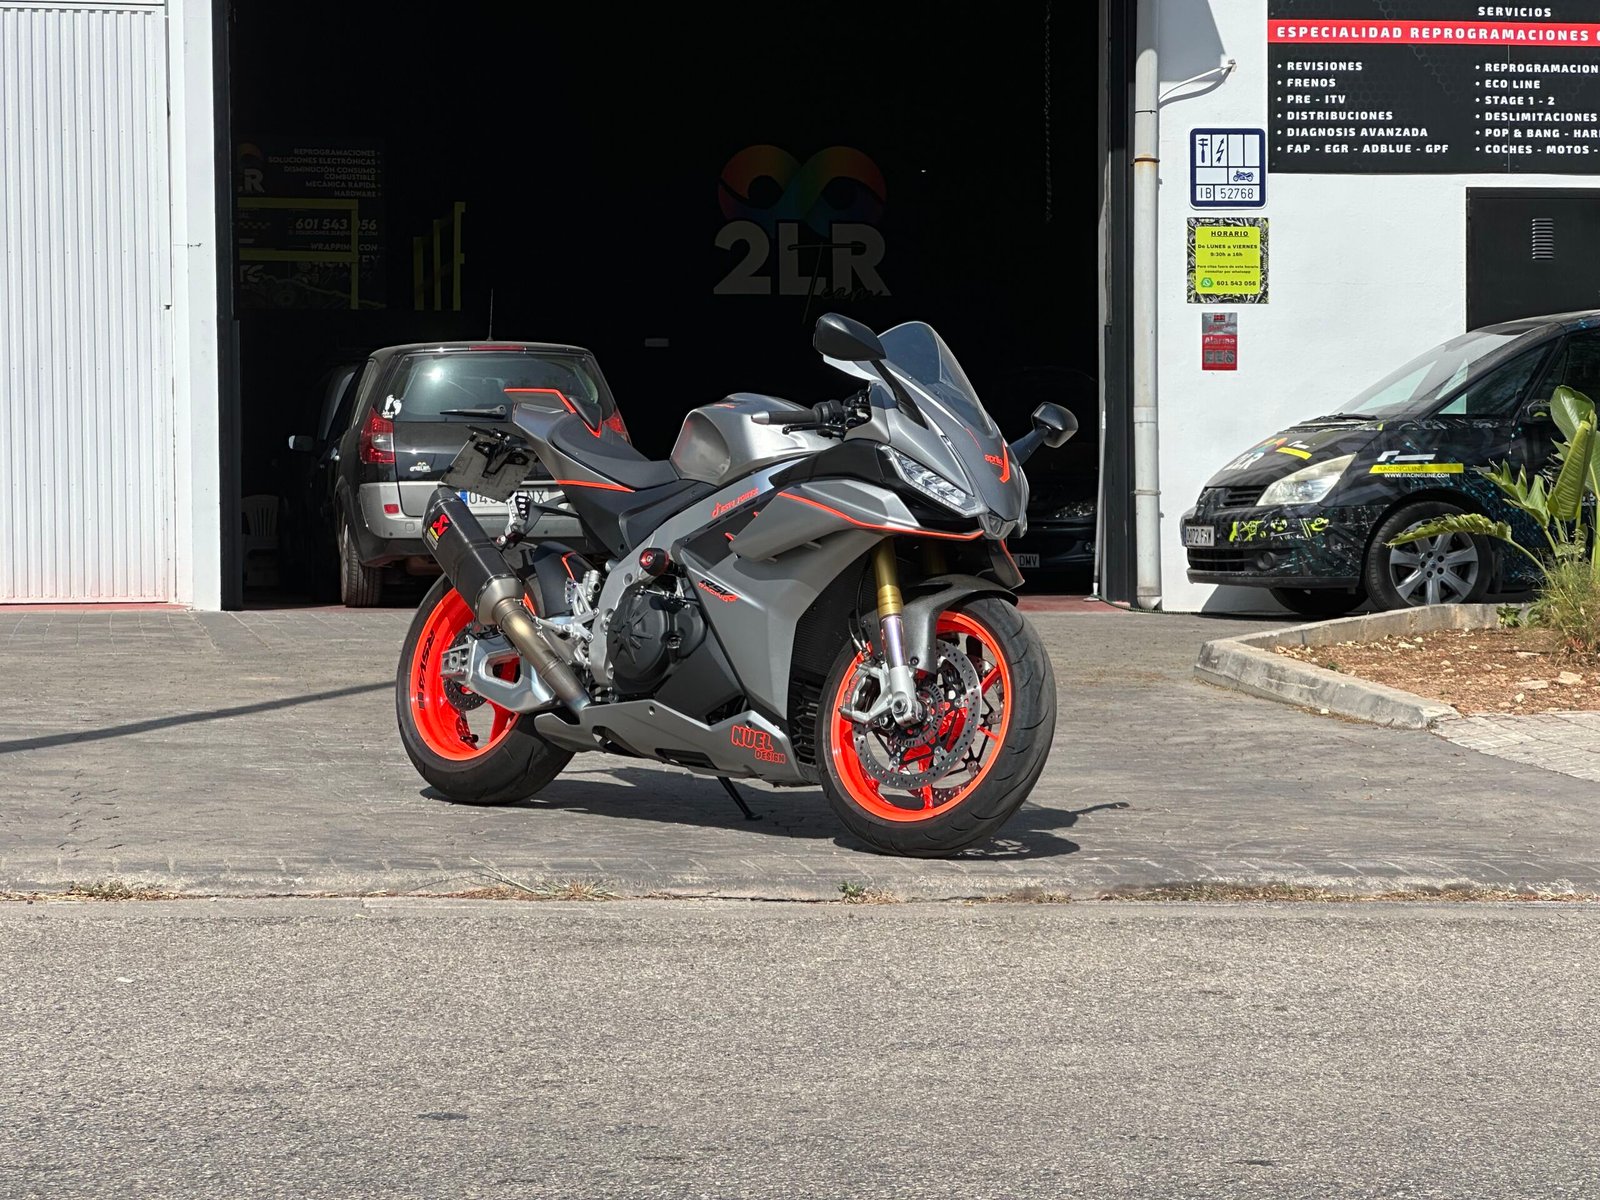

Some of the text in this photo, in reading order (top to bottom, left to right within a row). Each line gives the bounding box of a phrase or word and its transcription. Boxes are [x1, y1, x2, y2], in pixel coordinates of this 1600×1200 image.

[1478, 6, 1552, 17] SERVICIOS
[1277, 26, 1402, 39] ESPECIALIDAD
[1410, 27, 1589, 41] REPROGRAMACIONES
[1286, 61, 1363, 71] REVISIONES
[1286, 78, 1336, 88] FRENOS
[1484, 79, 1541, 89] ECO LINE
[1286, 94, 1311, 104] PRE
[1324, 94, 1346, 104] ITV
[1484, 96, 1524, 105] STAGE
[1527, 96, 1534, 105] 1
[1547, 96, 1555, 106] 2
[1286, 111, 1393, 121] DISTRIBUCIONES
[1484, 112, 1598, 122] DESLIMITACIONES
[1286, 127, 1428, 137] DIAGNOSIS AVANZADA
[1484, 128, 1510, 138] POP
[1513, 128, 1523, 138] &
[1526, 128, 1560, 138] BANG
[293, 147, 376, 157] REPROGRAMACIONES
[1286, 144, 1311, 154] FAP
[1324, 144, 1349, 154] EGR
[1362, 144, 1412, 154] ADBLUE
[1425, 144, 1449, 154] GPF
[1484, 145, 1533, 155] COCHES
[1546, 145, 1590, 155] MOTOS
[267, 156, 318, 164] SOLUCIONES
[333, 190, 376, 198] HARDWARE
[1220, 187, 1254, 200] 52768
[295, 217, 320, 230] 601
[321, 217, 348, 230] 543
[358, 243, 378, 251] CON
[713, 219, 893, 296] 2LR
[1019, 555, 1038, 567] DMV
[731, 725, 774, 751] NUEL
[755, 750, 787, 764] DESIGN
